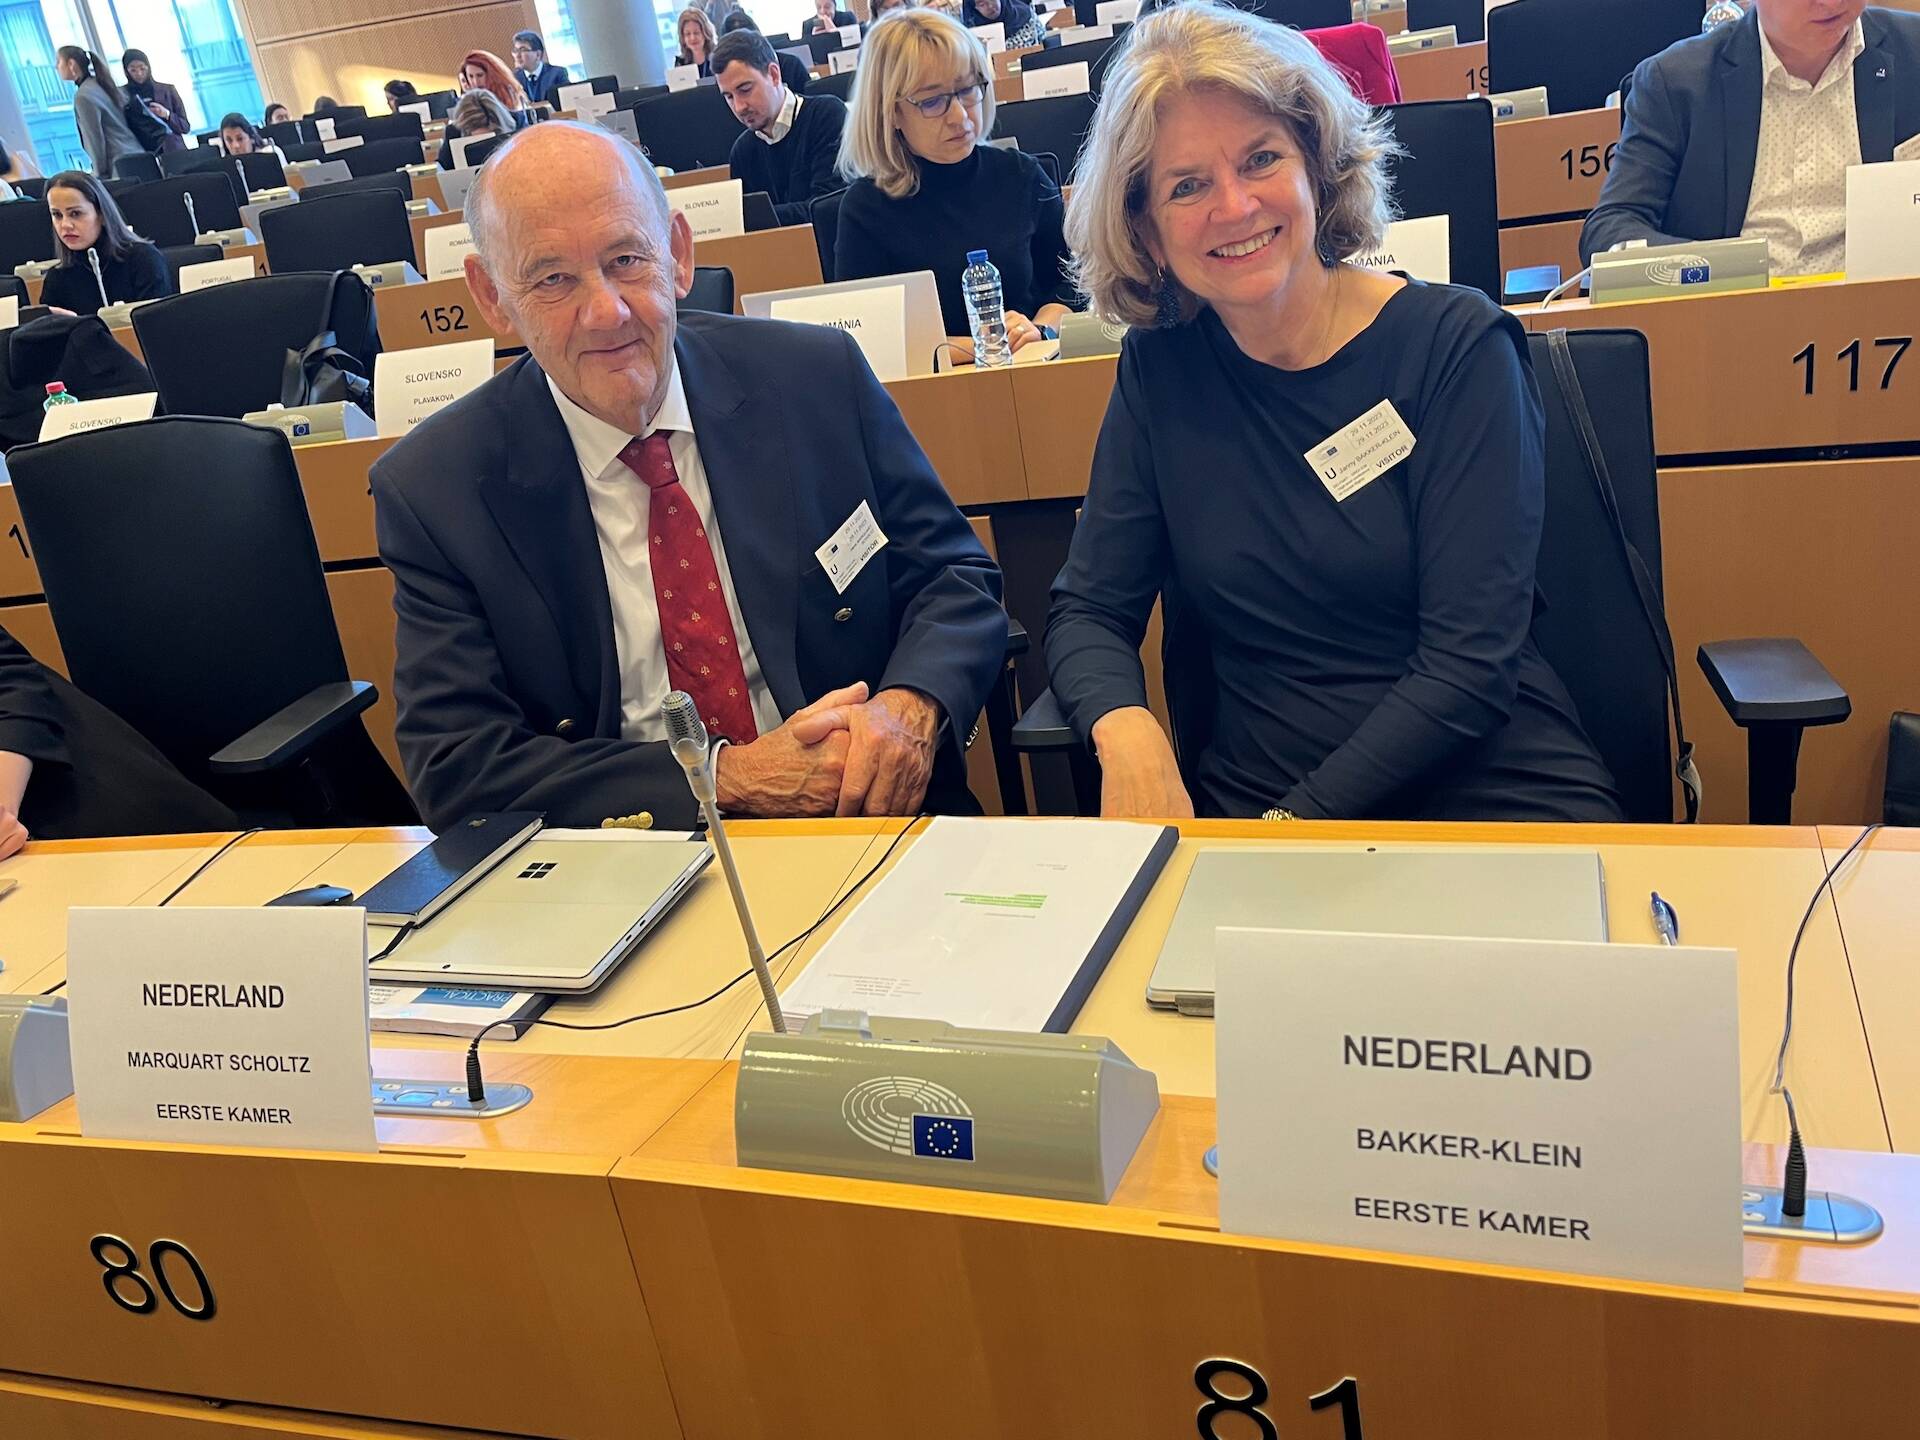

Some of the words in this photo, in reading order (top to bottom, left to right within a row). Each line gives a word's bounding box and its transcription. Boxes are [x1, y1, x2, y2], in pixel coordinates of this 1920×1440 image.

[420, 305, 469, 334] 152
[405, 367, 462, 384] SLOVENSKO
[1792, 336, 1913, 395] 117
[413, 393, 455, 405] PLAVAKOVA
[69, 417, 122, 430] SLOVENSKO
[1376, 444, 1409, 468] VISITOR
[860, 540, 879, 561] VISITOR
[142, 983, 285, 1009] NEDERLAND
[127, 1051, 224, 1070] MARQUART
[229, 1054, 311, 1073] SCHOLTZ
[1343, 1034, 1593, 1082] NEDERLAND
[156, 1103, 223, 1121] EERSTE
[228, 1106, 292, 1124] KAMER
[1356, 1128, 1582, 1169] BAKKER-KLEIN
[1354, 1197, 1469, 1228] EERSTE
[1479, 1209, 1590, 1241] KAMER
[90, 1233, 217, 1321] 80
[1193, 1357, 1363, 1440] 81
